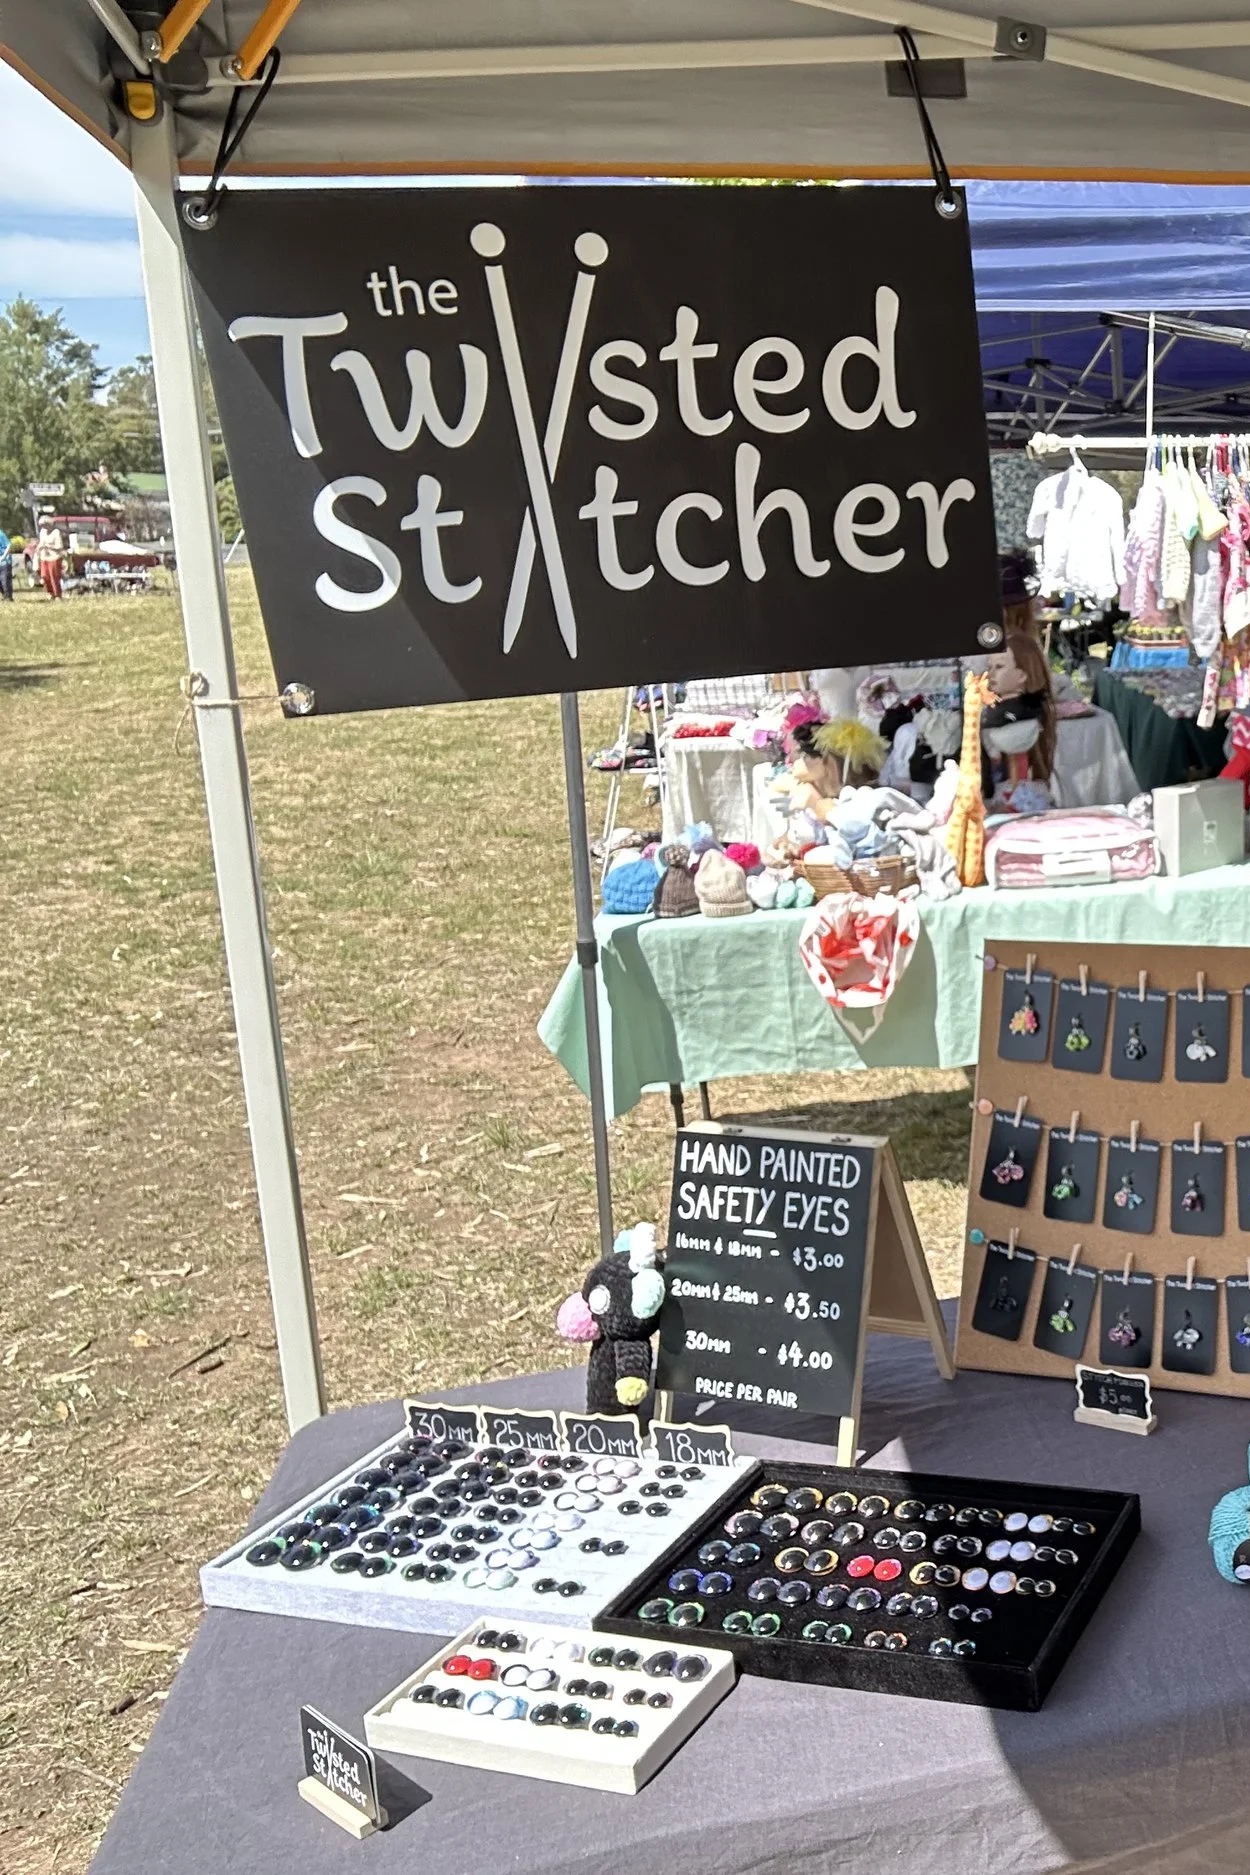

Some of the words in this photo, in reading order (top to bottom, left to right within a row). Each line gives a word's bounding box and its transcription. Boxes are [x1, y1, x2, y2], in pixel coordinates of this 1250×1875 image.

[366, 265, 459, 317] the
[227, 285, 917, 459] Twisted
[313, 442, 976, 613] Stitcher
[680, 1139, 751, 1176] HAND
[760, 1146, 861, 1189] PAINTED
[677, 1181, 776, 1225] SAFETY
[783, 1191, 850, 1236] EYES
[793, 1246, 844, 1272] $3.00
[784, 1292, 841, 1320] $3.50
[685, 1330, 731, 1354] 30MM
[777, 1341, 833, 1370] $4.00
[695, 1377, 734, 1398] PRICE
[736, 1383, 763, 1403] PER
[766, 1388, 798, 1409] PAIR
[494, 1419, 554, 1449] 25MM
[573, 1423, 634, 1455] 20MM
[665, 1432, 725, 1466] 18MM
